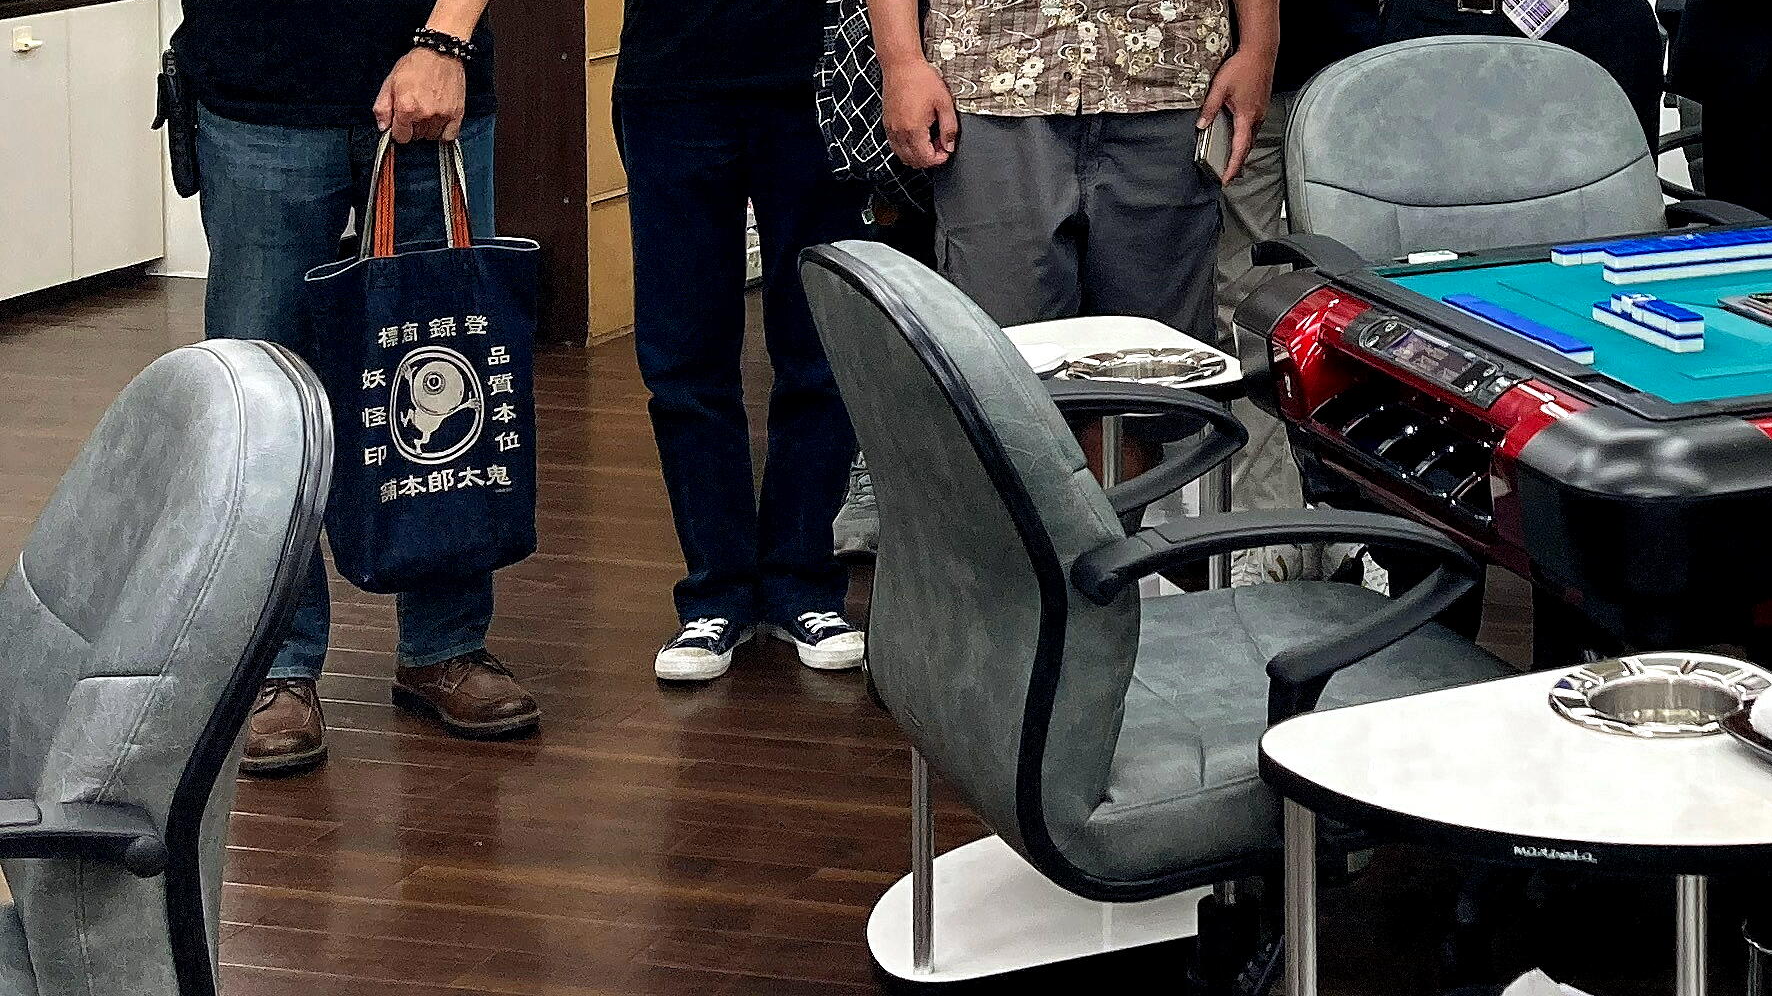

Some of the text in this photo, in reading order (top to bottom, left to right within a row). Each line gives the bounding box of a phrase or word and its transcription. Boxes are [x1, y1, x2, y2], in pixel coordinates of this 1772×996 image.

[361, 367, 388, 467] 妖怪印
[486, 345, 521, 453] 品質本位
